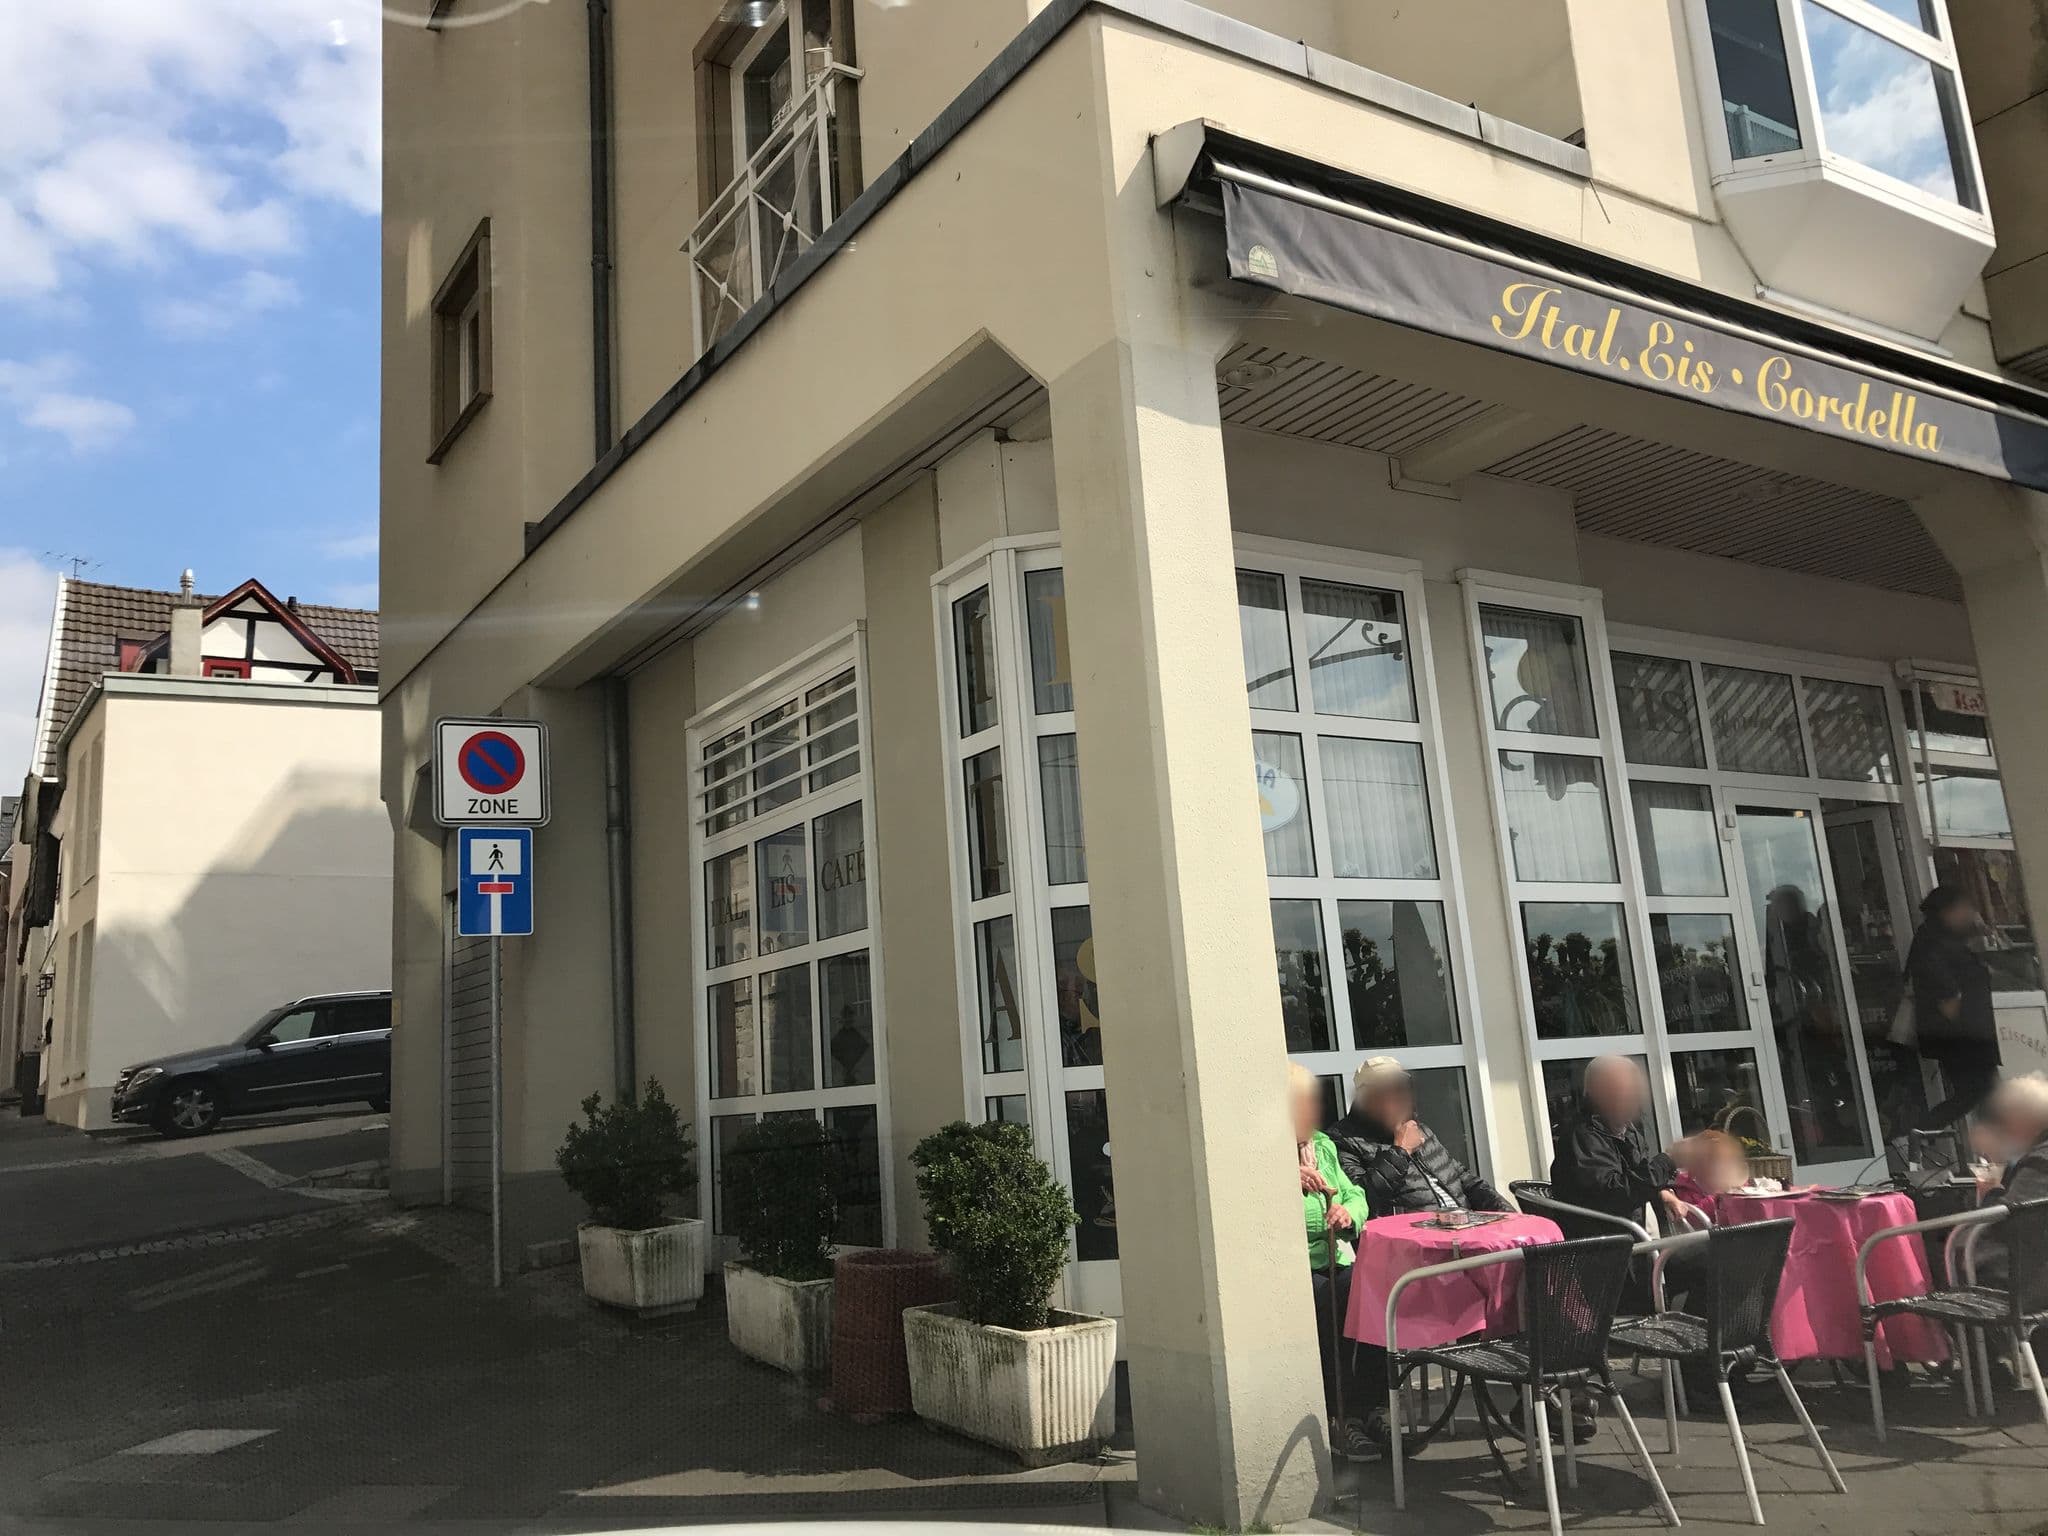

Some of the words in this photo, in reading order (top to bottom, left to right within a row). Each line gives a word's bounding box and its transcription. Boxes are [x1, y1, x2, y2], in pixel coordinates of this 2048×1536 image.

[1640, 320, 1722, 394] Eis
[1757, 356, 1943, 453] Cordella
[468, 799, 519, 814] ZONE
[771, 873, 797, 909] EIS
